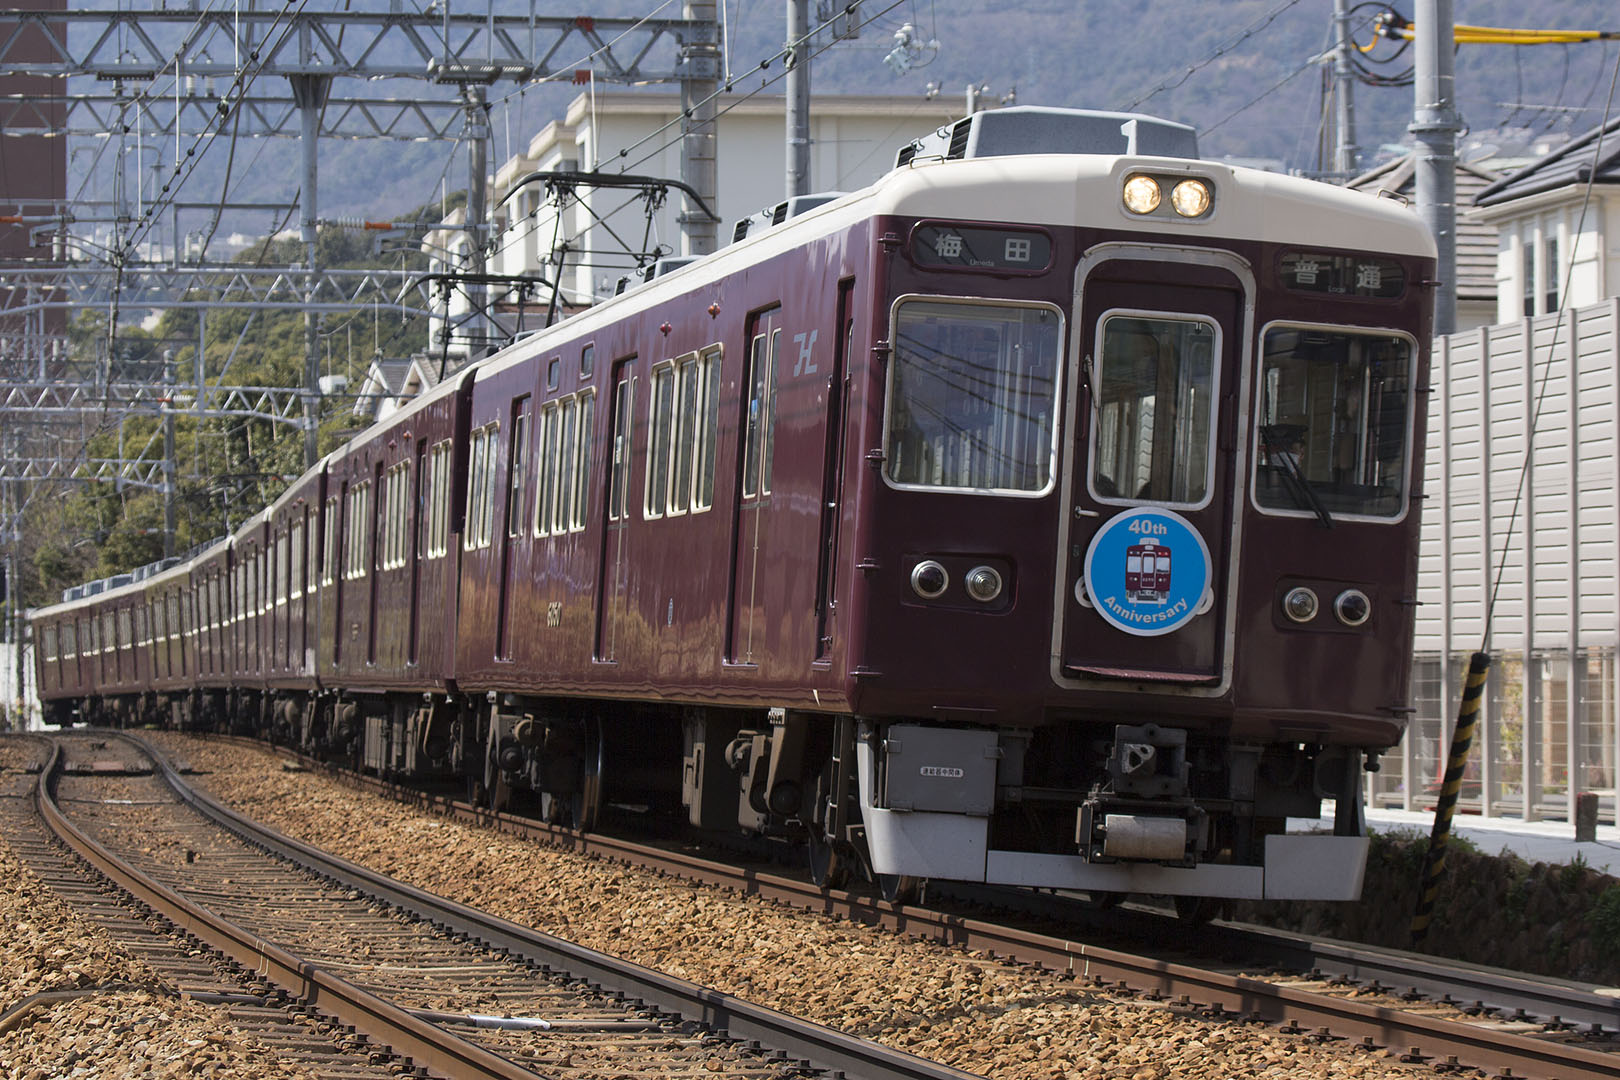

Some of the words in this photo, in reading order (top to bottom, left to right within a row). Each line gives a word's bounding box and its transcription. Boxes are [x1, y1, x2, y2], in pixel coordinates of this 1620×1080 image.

[935, 233, 1030, 262] 梅田
[1294, 260, 1382, 289] 普通
[1128, 519, 1168, 535] 40th
[1104, 595, 1188, 623] Anniversary
